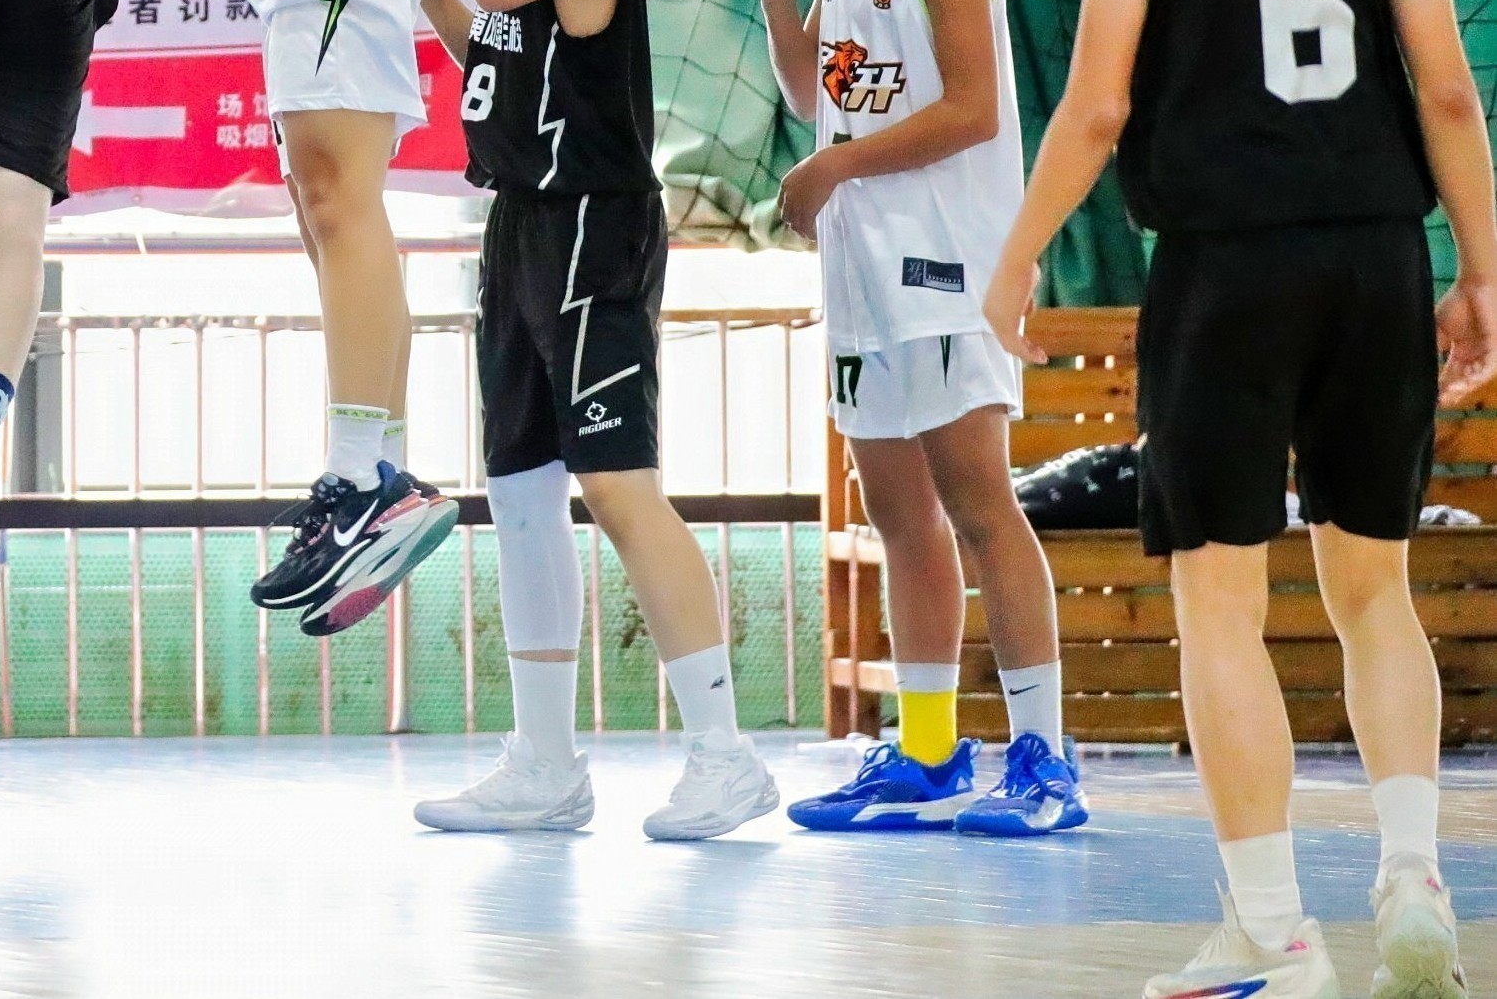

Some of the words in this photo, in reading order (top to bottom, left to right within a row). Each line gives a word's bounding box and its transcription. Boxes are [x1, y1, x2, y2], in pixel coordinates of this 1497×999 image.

[460, 63, 496, 122] 8
[836, 354, 863, 408] 17
[578, 416, 622, 437] RIGORER
